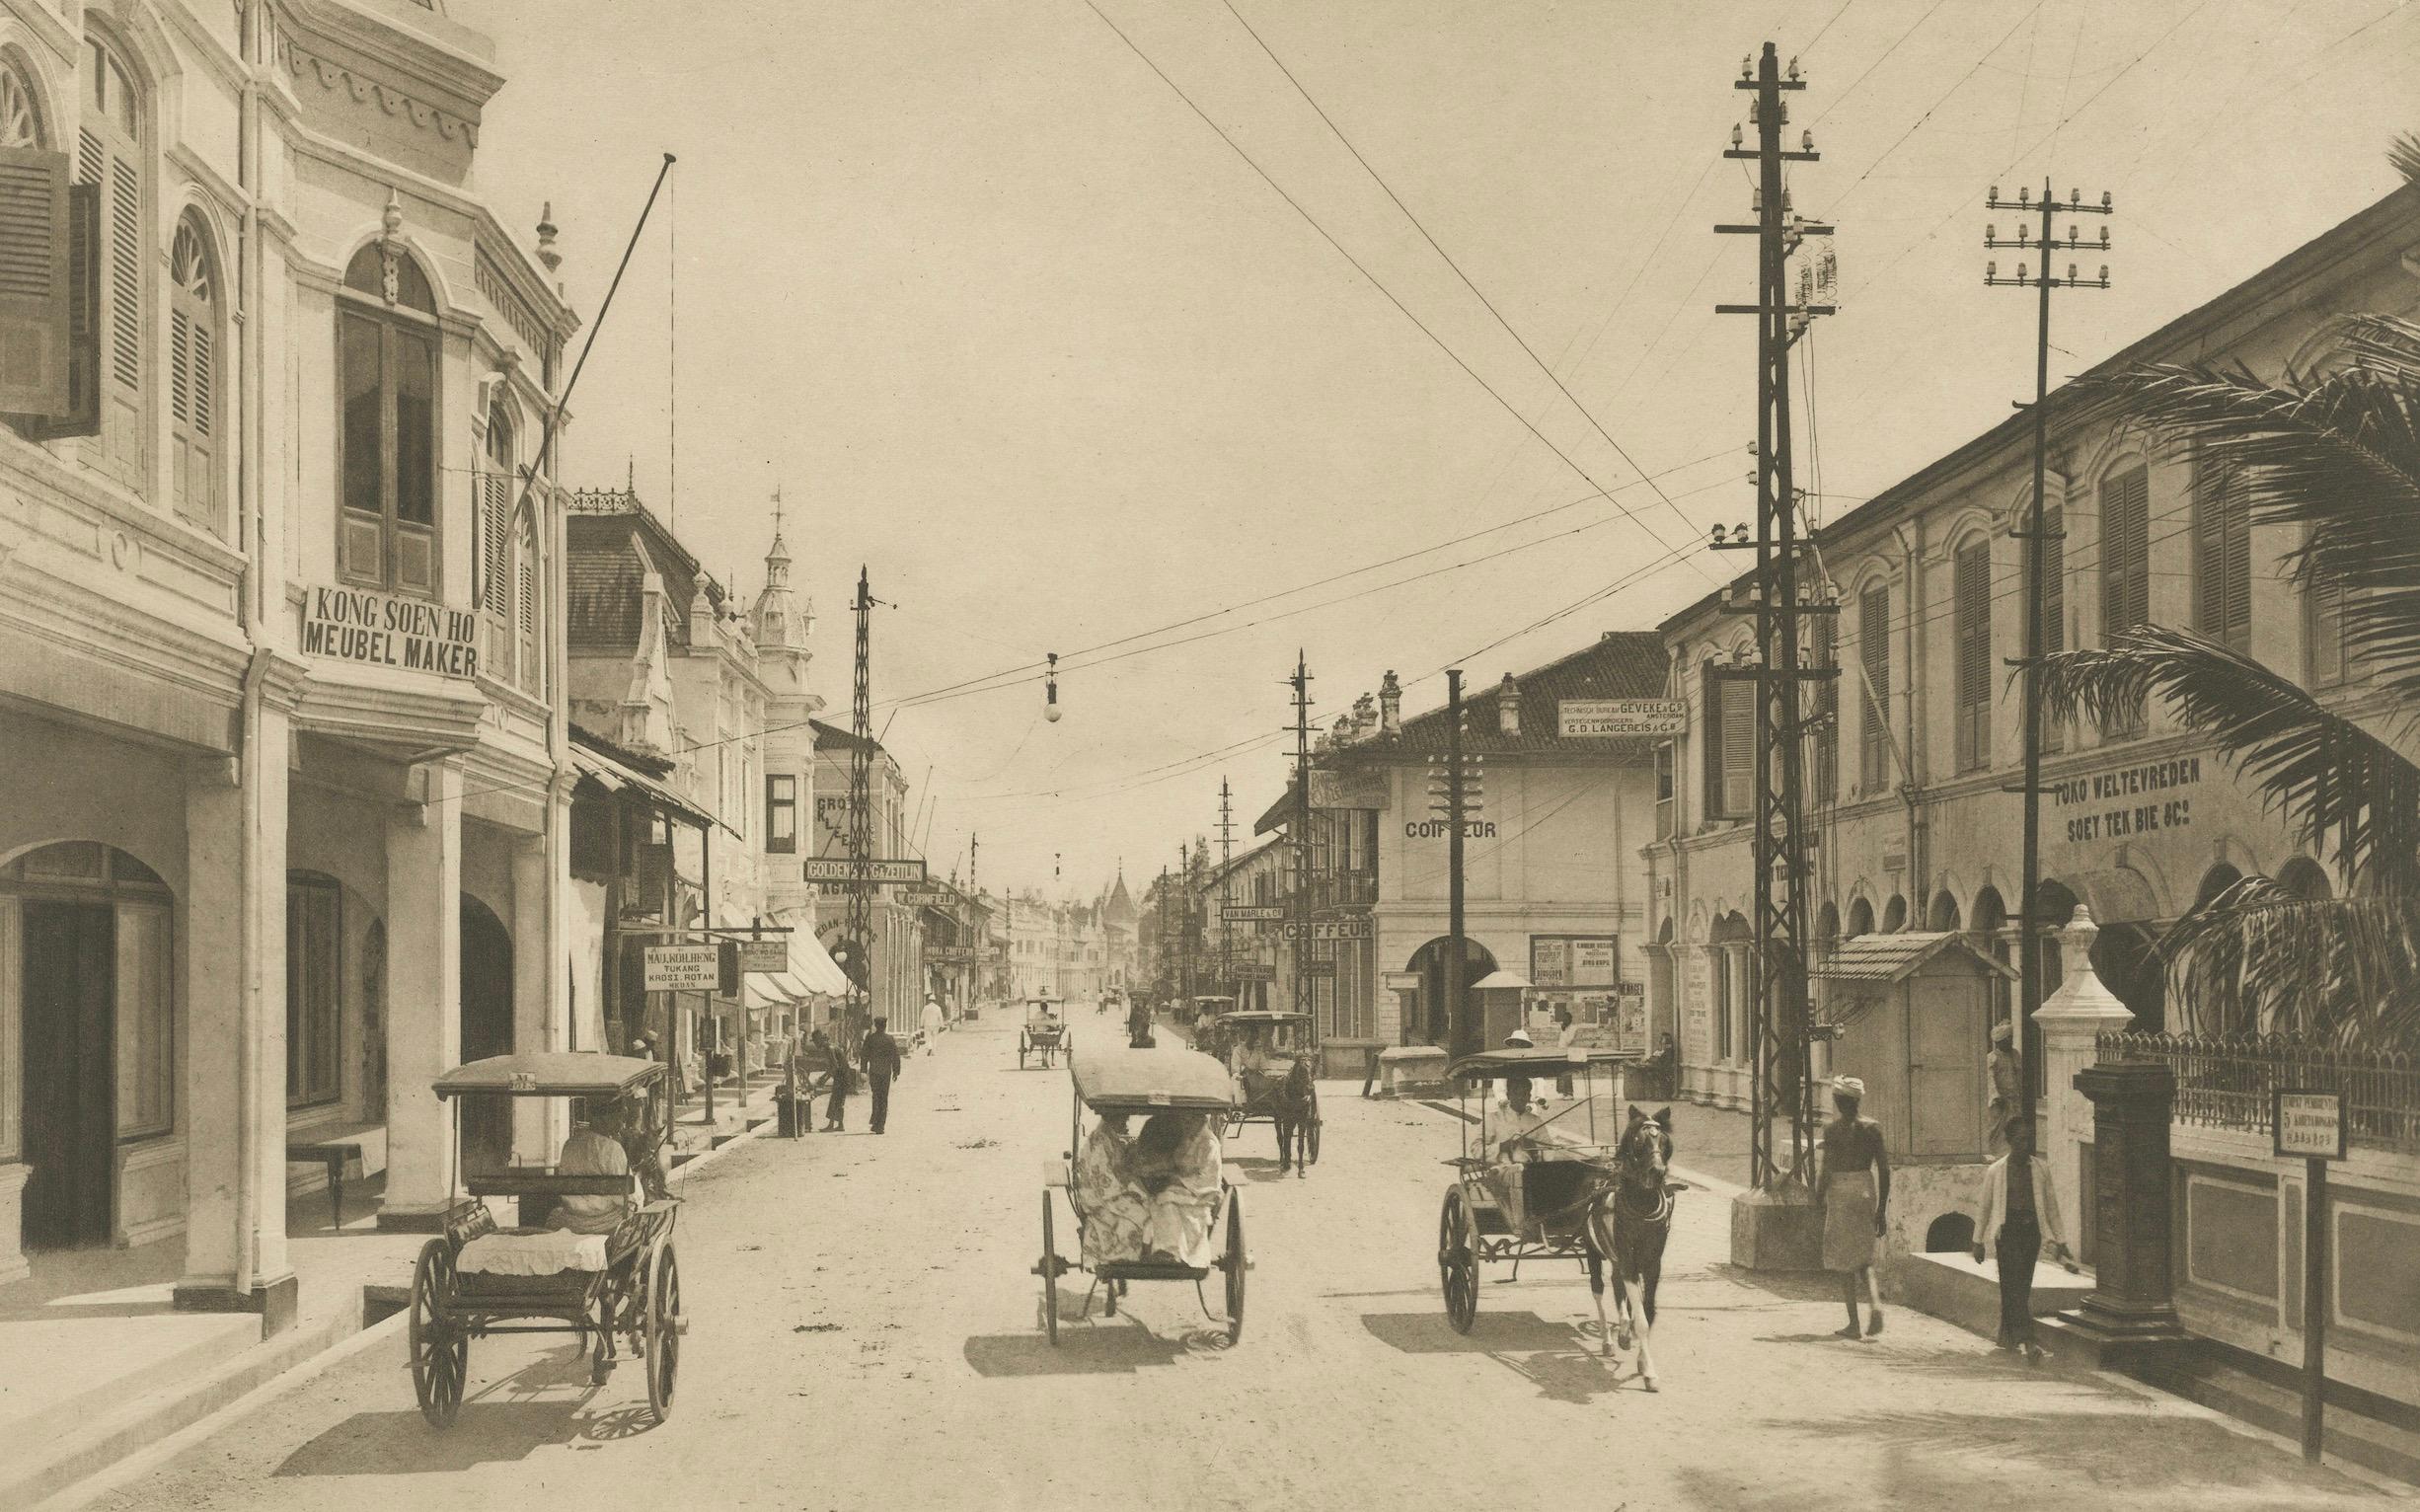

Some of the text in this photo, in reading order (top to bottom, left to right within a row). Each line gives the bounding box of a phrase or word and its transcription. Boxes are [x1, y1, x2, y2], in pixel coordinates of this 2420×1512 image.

[316, 587, 476, 643] KONG SOEN HO
[306, 621, 477, 677] MEUBEL MAKER
[1621, 703, 1661, 714] GEVEKE
[2054, 758, 2200, 806] TOKO WELTEVREDEN
[1404, 821, 1496, 838] COIFEUR
[2068, 815, 2100, 843] SOEY
[2104, 810, 2131, 838] TEK
[2135, 805, 2159, 833] BIE
[1225, 909, 1240, 918] VAN
[1241, 909, 1265, 918] MARLE
[663, 964, 700, 973] TUKANG
